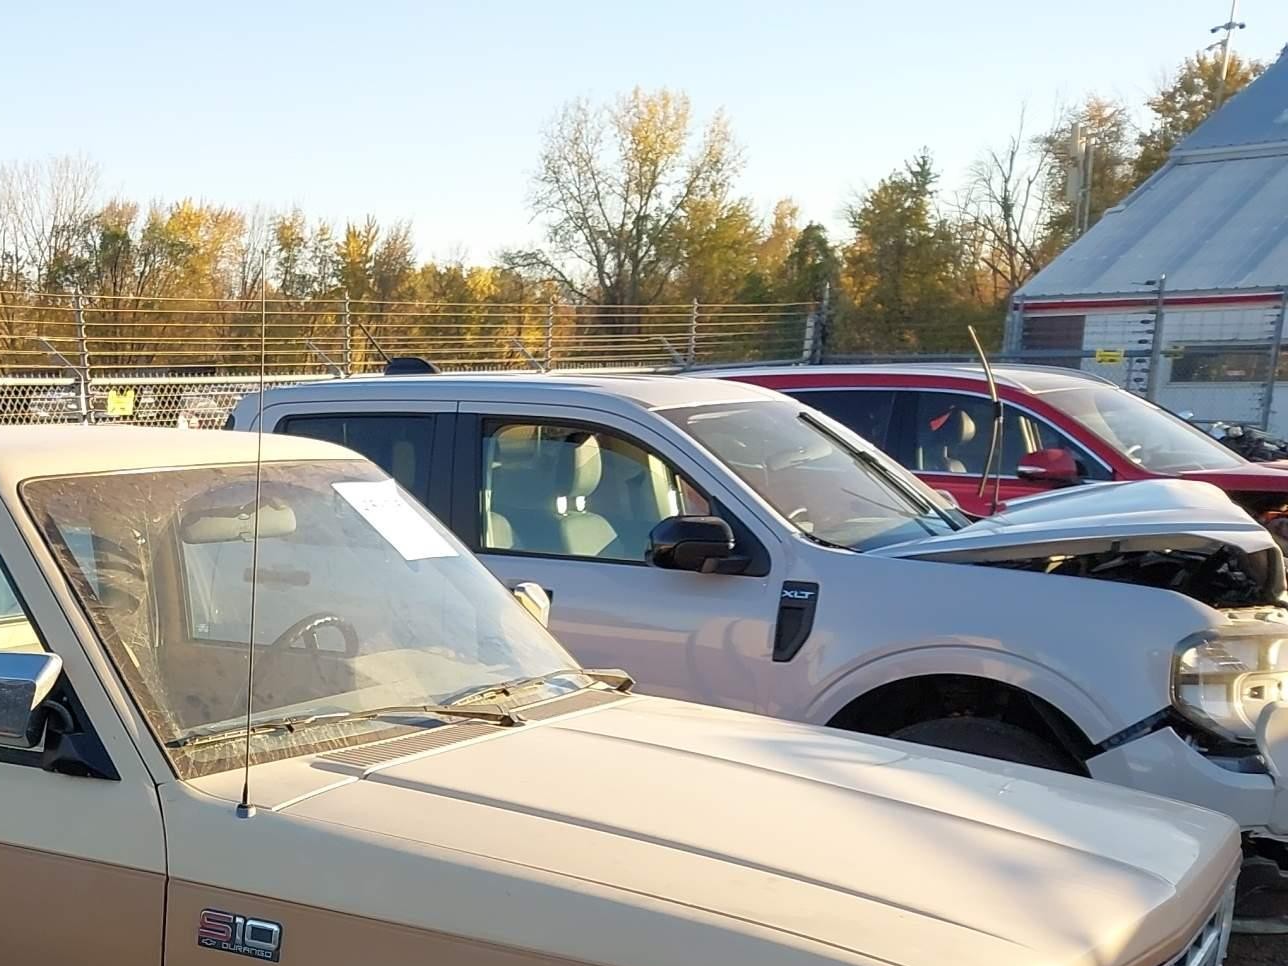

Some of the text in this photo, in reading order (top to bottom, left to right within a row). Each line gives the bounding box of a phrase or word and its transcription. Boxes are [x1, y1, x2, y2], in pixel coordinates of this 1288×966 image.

[782, 590, 816, 599] XLT
[199, 909, 281, 951] S10
[221, 941, 272, 958] DURANGO
